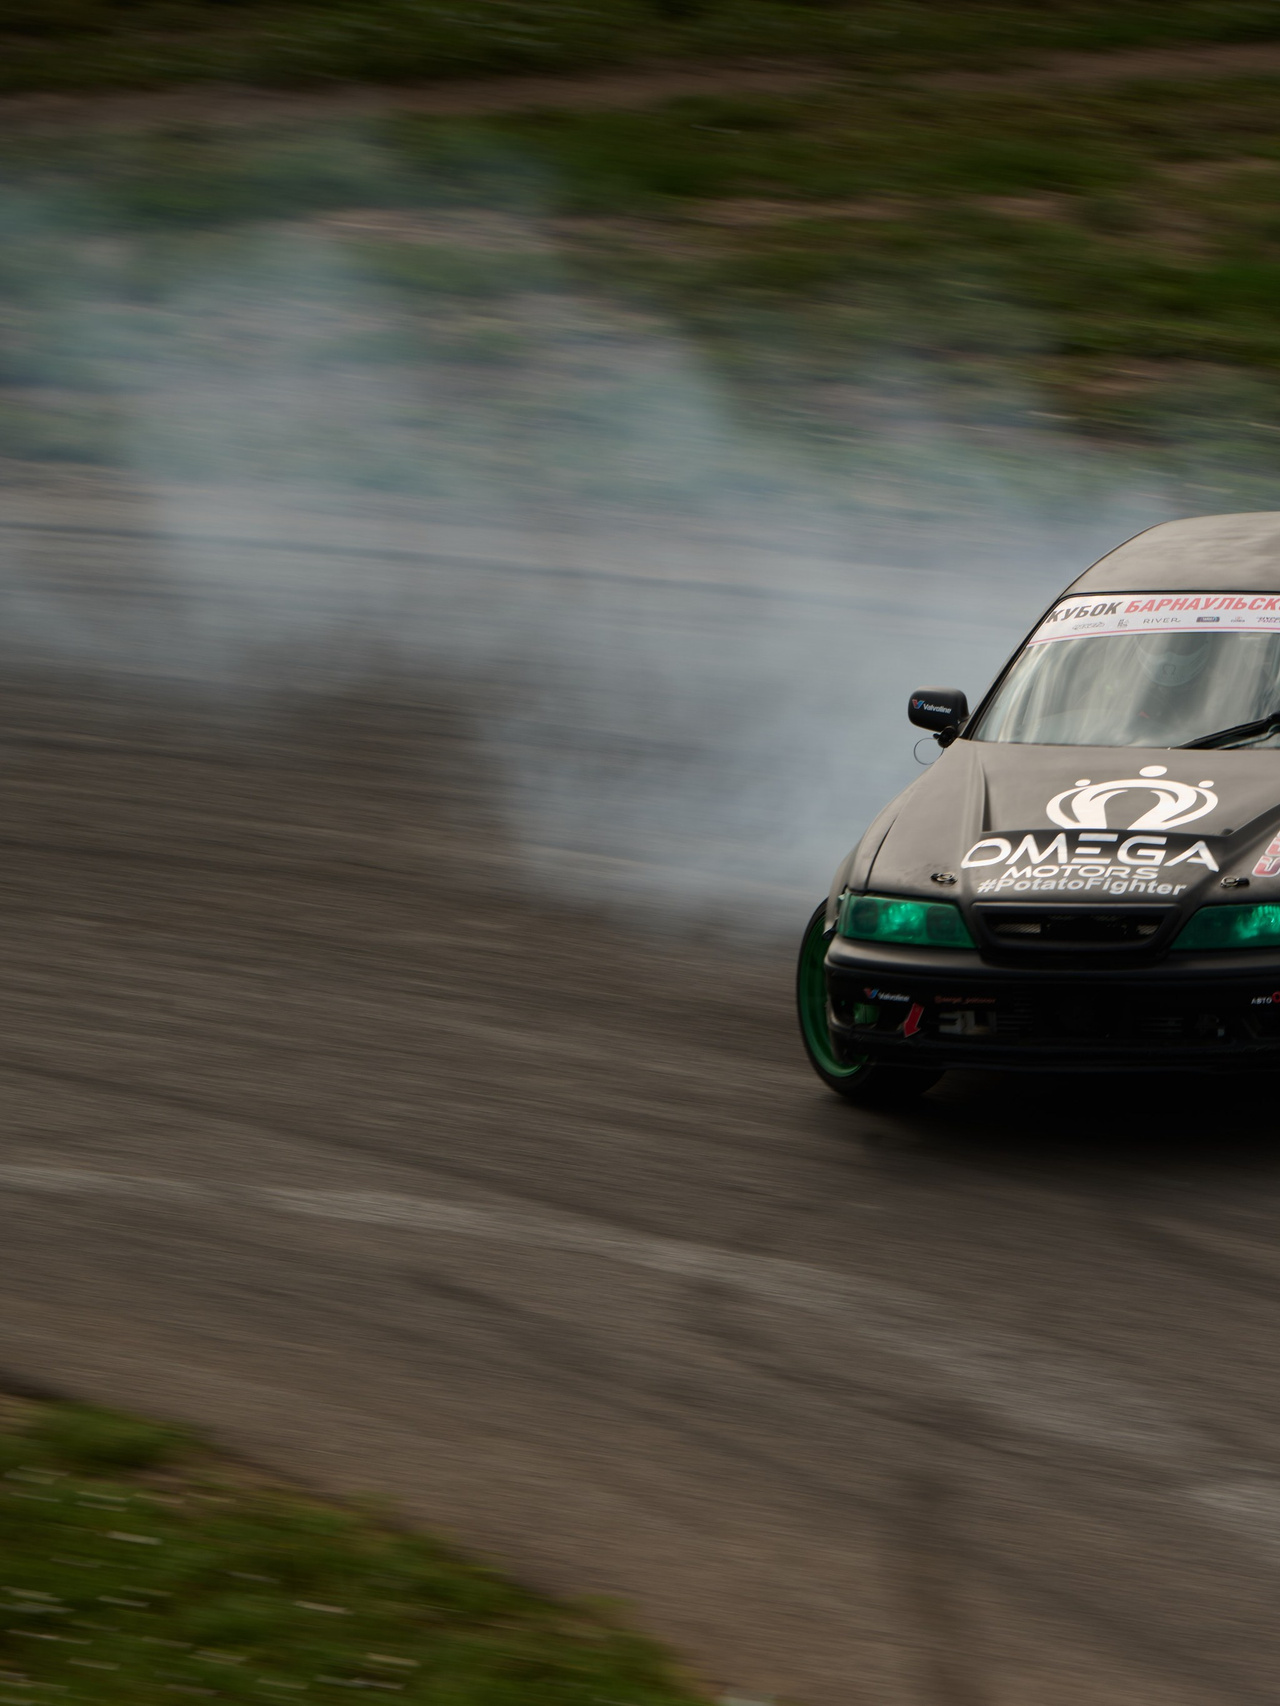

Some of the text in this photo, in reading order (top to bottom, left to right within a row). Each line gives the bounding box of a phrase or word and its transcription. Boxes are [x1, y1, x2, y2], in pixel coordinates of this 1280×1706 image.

[1045, 601, 1123, 624] КУБОК
[923, 703, 952, 714] Valvoline
[960, 832, 1220, 873] OMEGA
[1000, 865, 1159, 880] MOTORS
[977, 876, 1187, 896] #PotatoFighter
